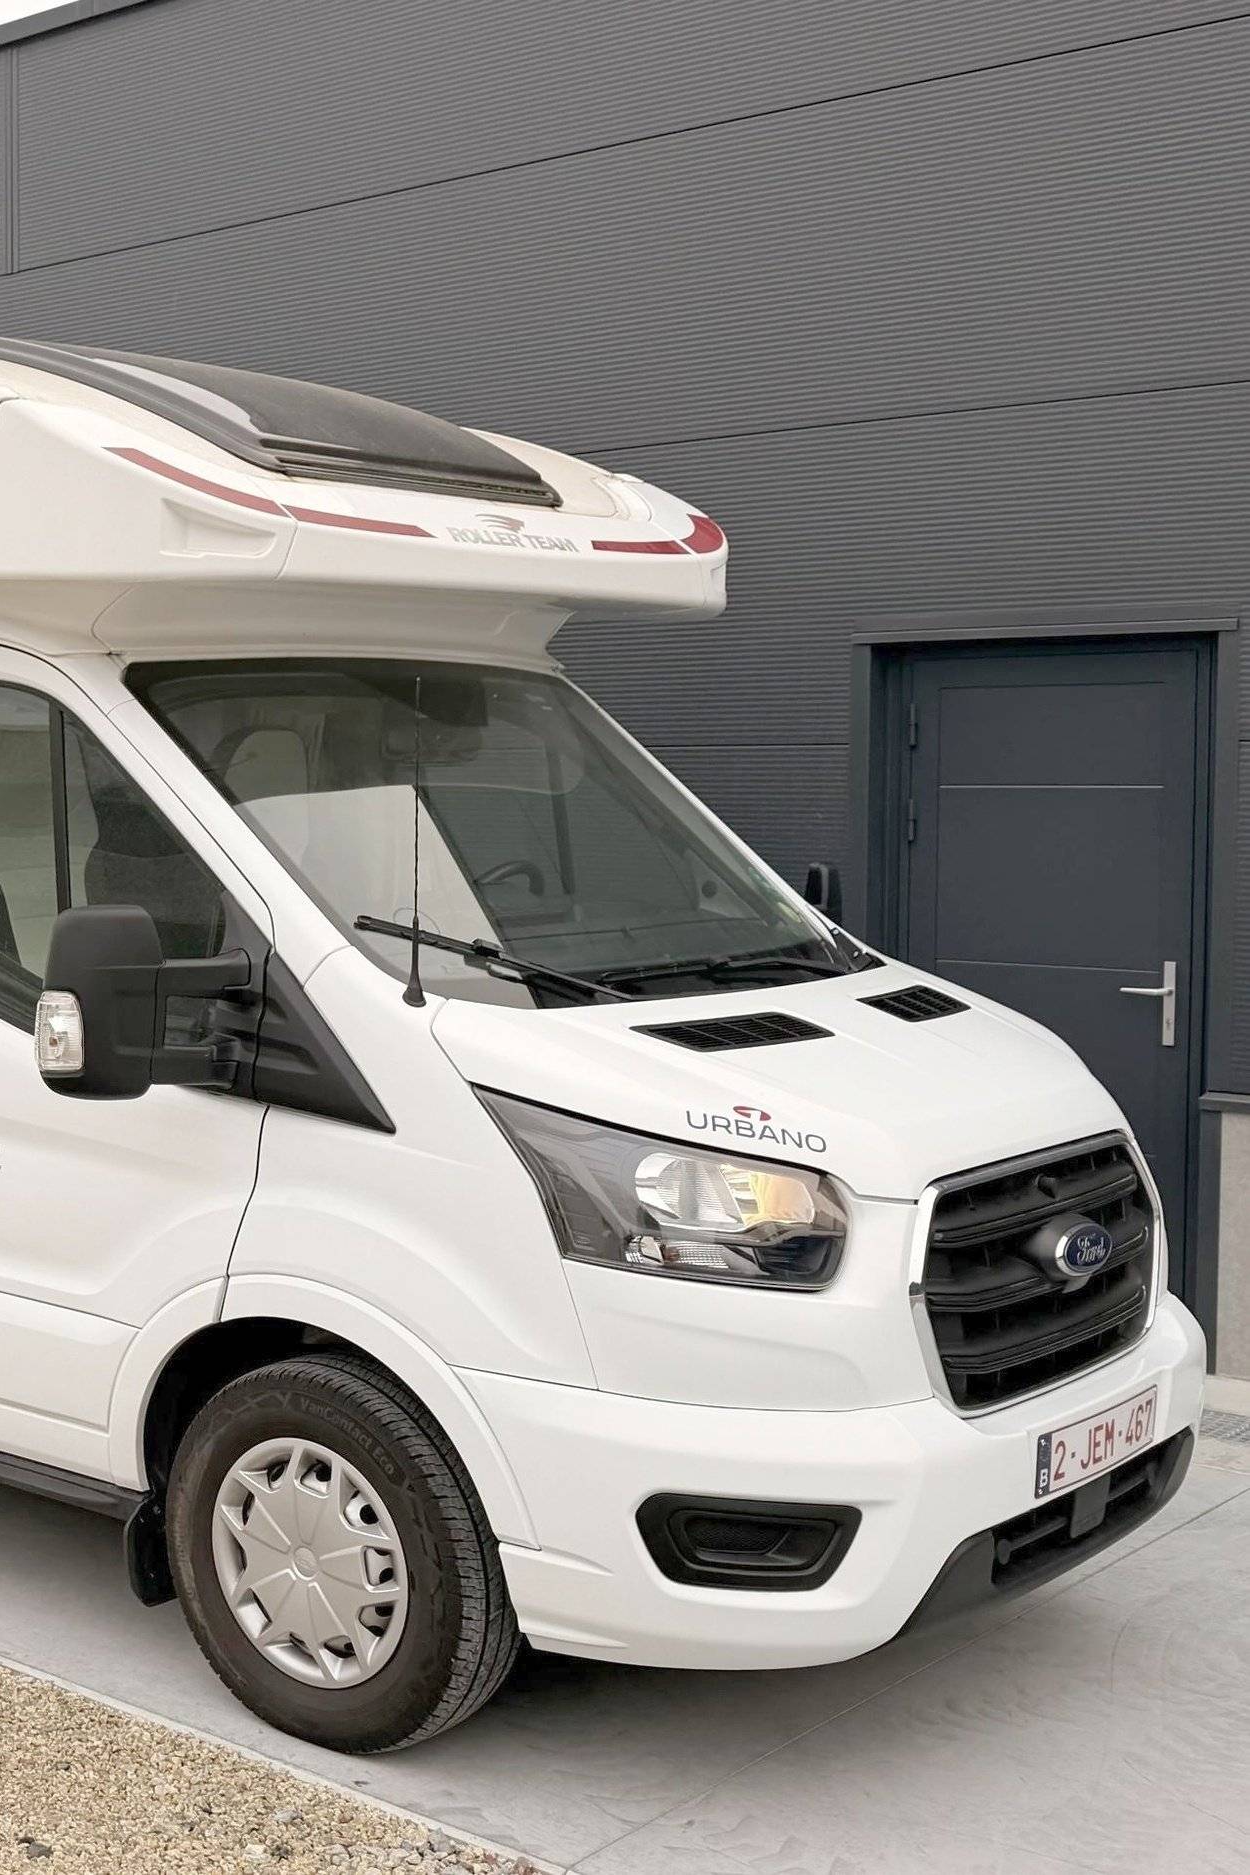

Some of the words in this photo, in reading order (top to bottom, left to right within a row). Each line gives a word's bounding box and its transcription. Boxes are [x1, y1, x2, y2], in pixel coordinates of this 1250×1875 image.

[446, 526, 525, 548] ROLLER
[522, 533, 580, 553] TEAM
[685, 1110, 827, 1153] URBANO
[1076, 1235, 1107, 1266] Ford
[1039, 1468, 1049, 1488] B
